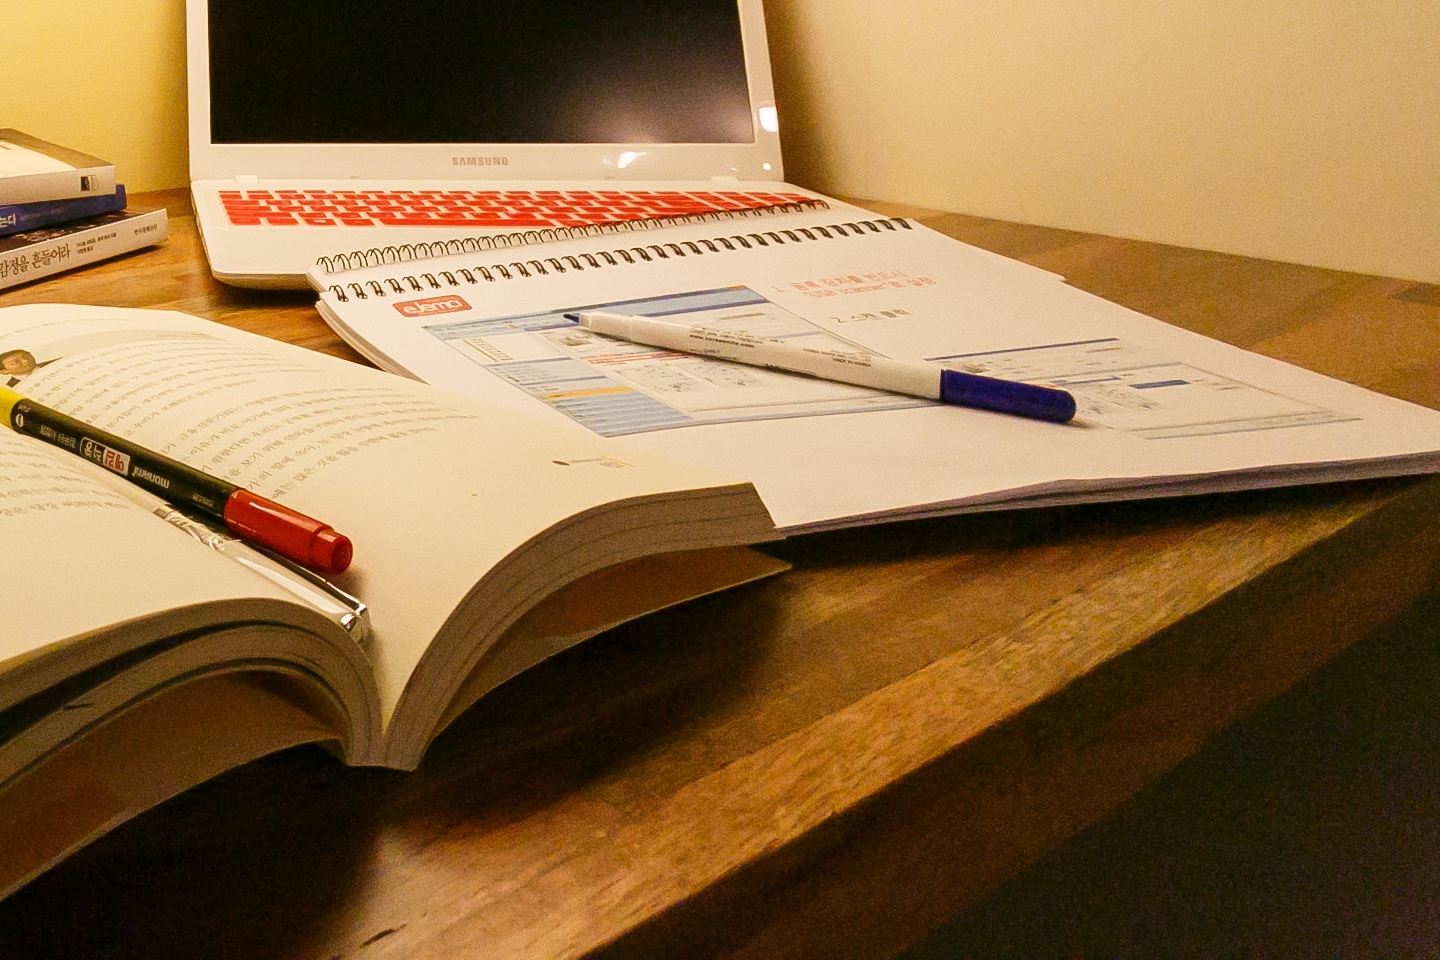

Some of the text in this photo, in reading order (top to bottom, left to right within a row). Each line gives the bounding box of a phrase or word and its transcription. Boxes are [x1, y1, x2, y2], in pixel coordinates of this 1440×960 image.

[452, 156, 509, 166] SAMSUNG
[31, 243, 71, 269] 흔들어라
[131, 465, 171, 489] monami
